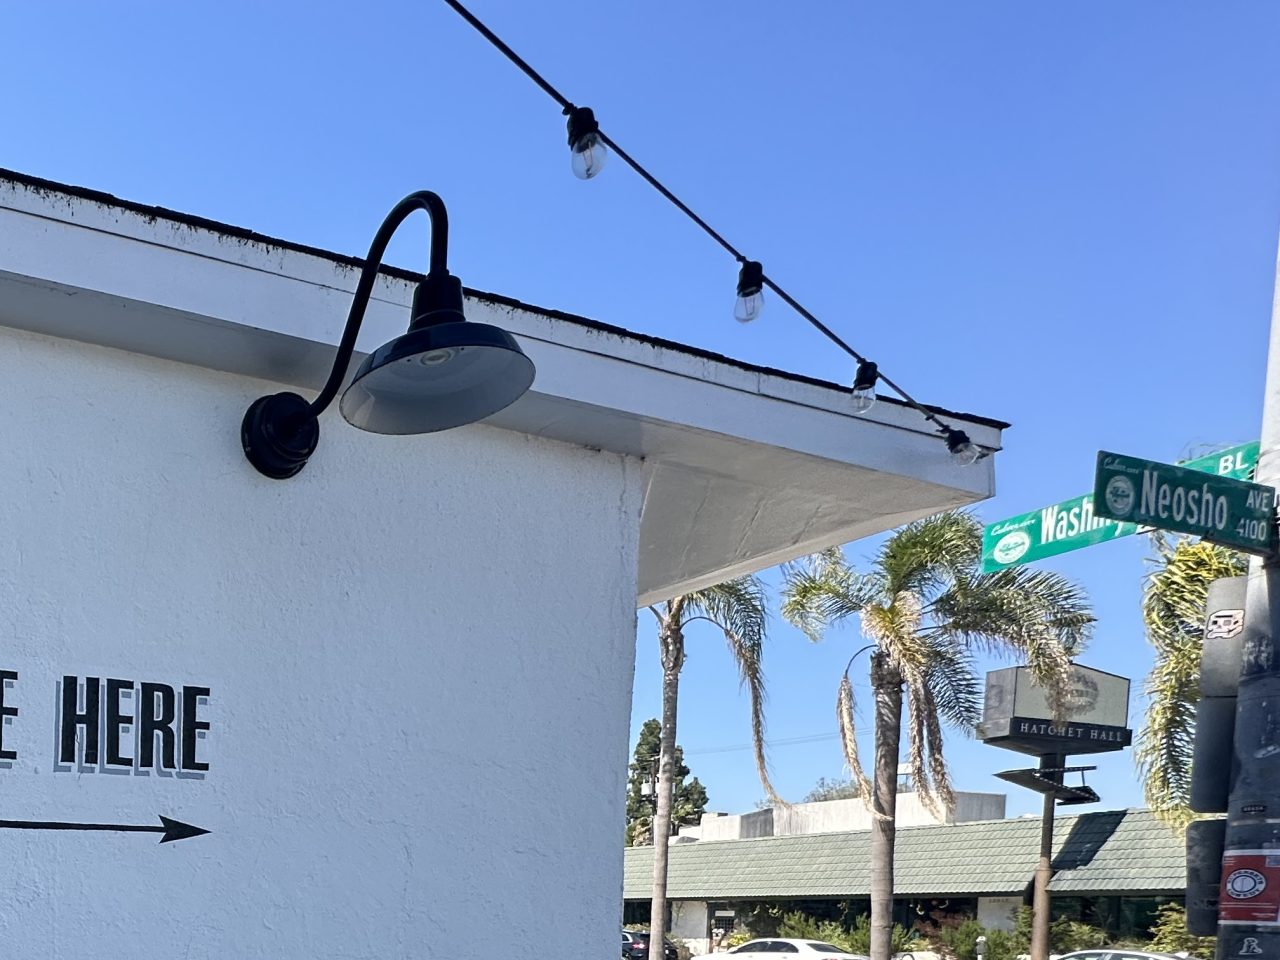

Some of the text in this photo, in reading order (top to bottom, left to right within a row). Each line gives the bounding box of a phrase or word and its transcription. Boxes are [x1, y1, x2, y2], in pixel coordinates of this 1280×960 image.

[1041, 451, 1249, 545] Wash BL
[1140, 469, 1228, 531] Neosho
[1246, 489, 1270, 512] AVE
[1235, 517, 1267, 541] 4100
[53, 675, 211, 780] HERE
[1090, 729, 1123, 742] HALL
